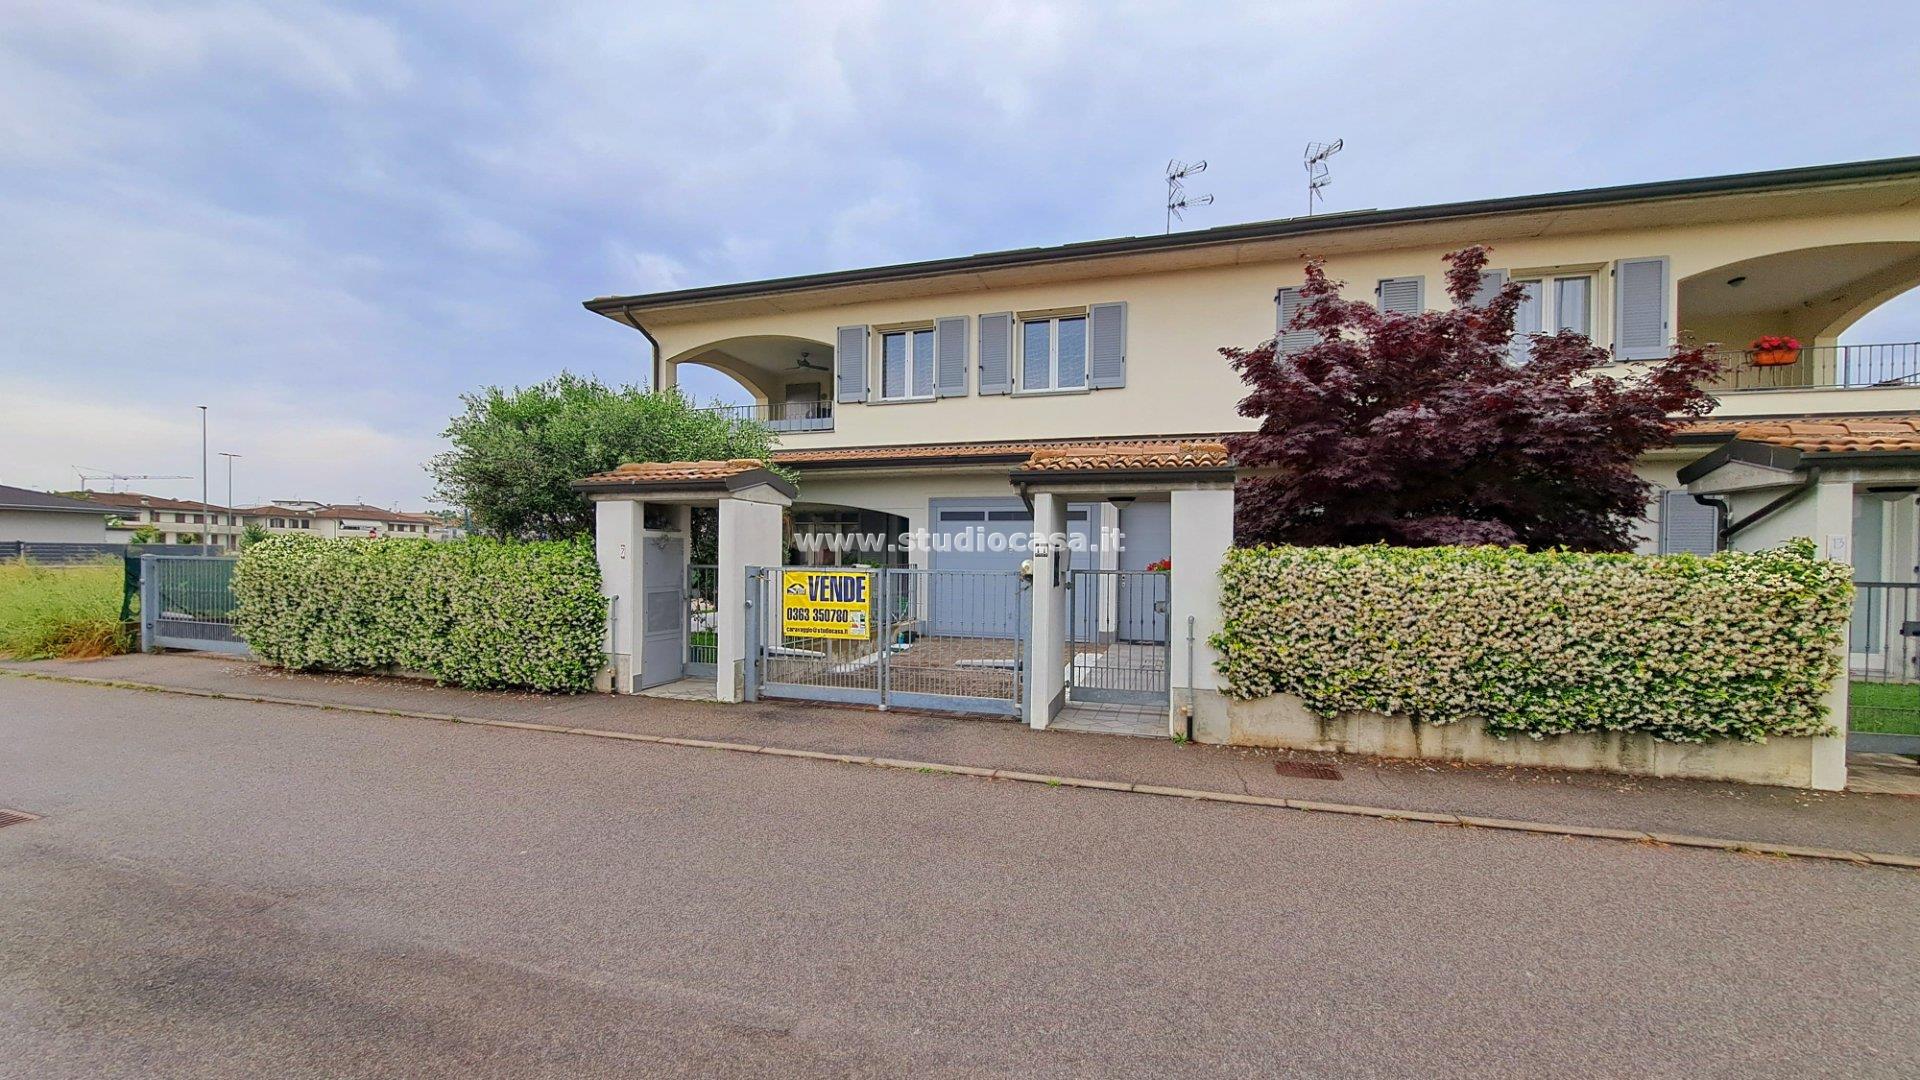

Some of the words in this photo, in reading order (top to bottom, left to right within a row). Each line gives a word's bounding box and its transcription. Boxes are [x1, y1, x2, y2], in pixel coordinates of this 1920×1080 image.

[808, 576, 866, 602] VENDE
[787, 607, 810, 621] 0363
[813, 608, 849, 623] 350780
